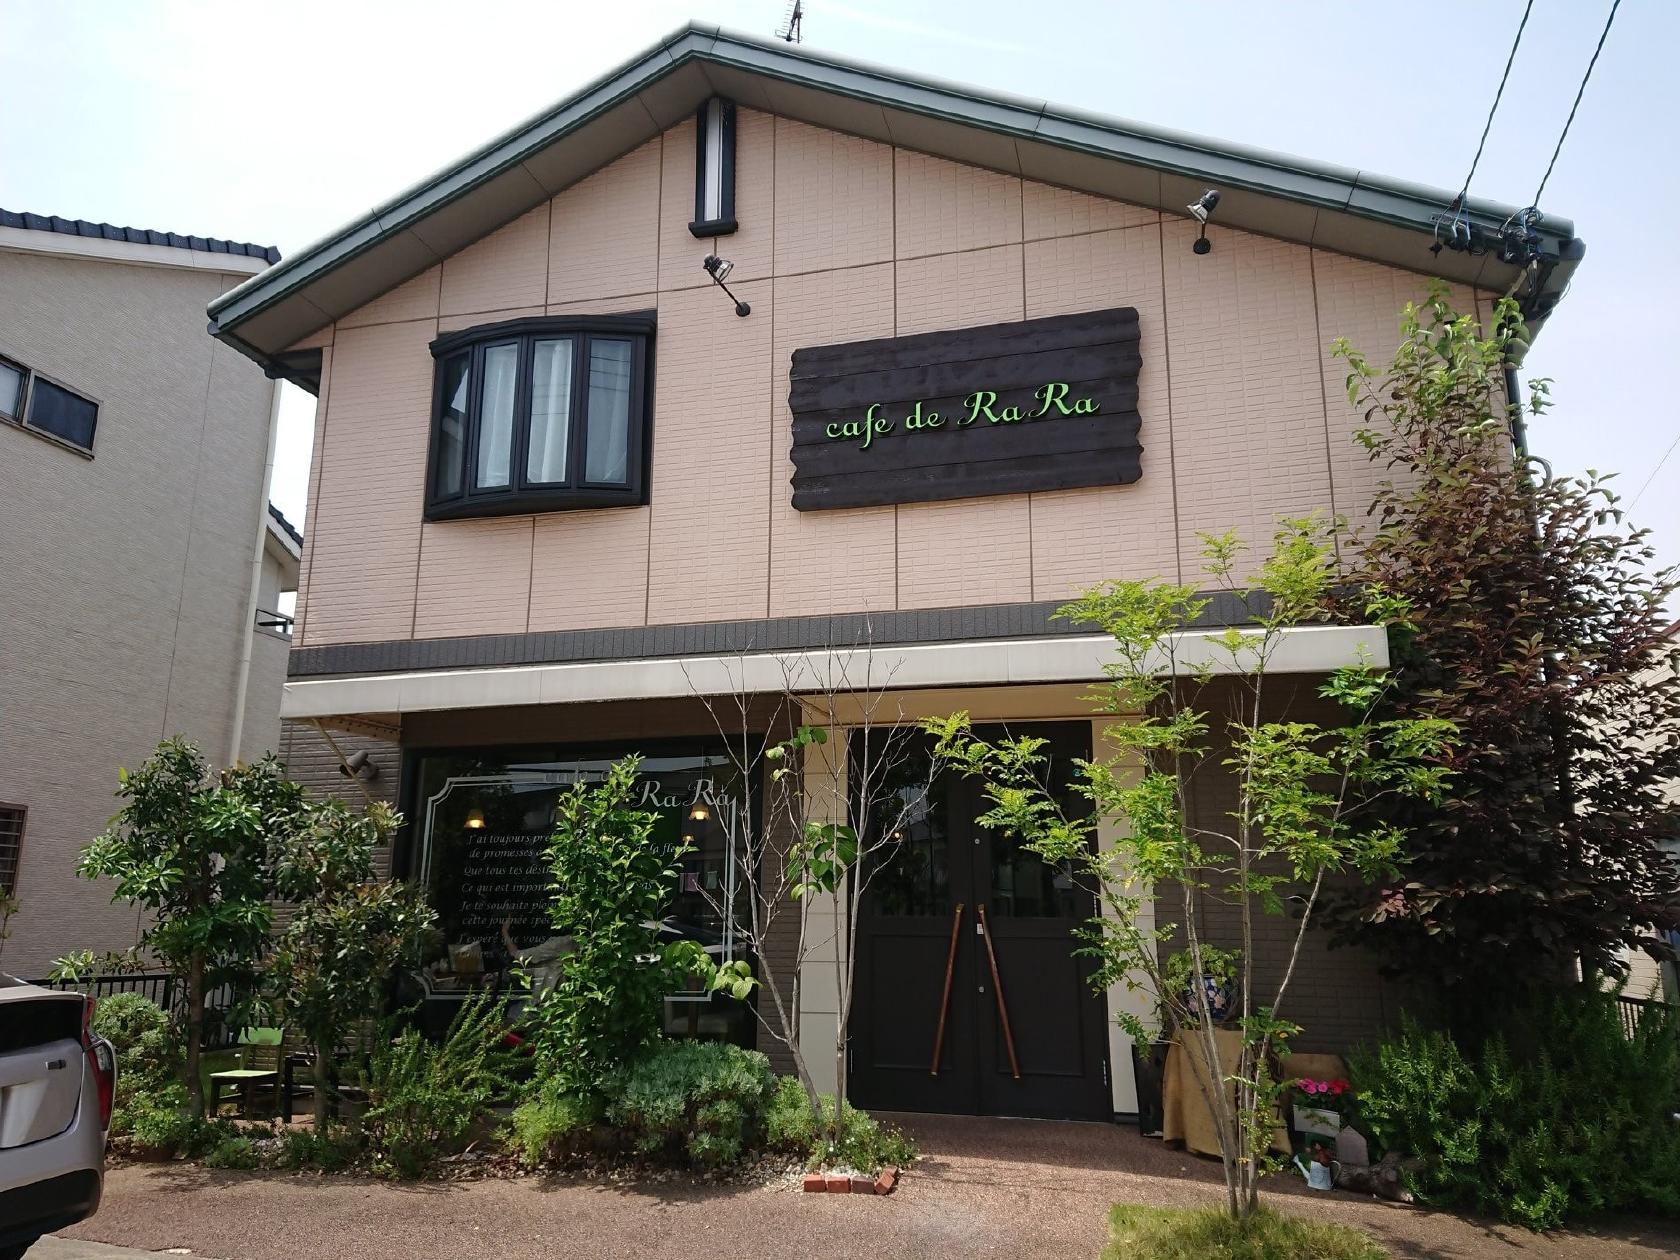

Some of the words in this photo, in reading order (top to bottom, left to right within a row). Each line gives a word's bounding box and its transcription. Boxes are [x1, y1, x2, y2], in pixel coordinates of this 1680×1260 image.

[826, 403, 895, 449] cafe
[905, 401, 948, 429] de
[957, 391, 1027, 425] Ra
[1028, 382, 1100, 416] Ra
[631, 780, 681, 808] Ra
[489, 833, 531, 846] toujours
[484, 849, 533, 861] promesses
